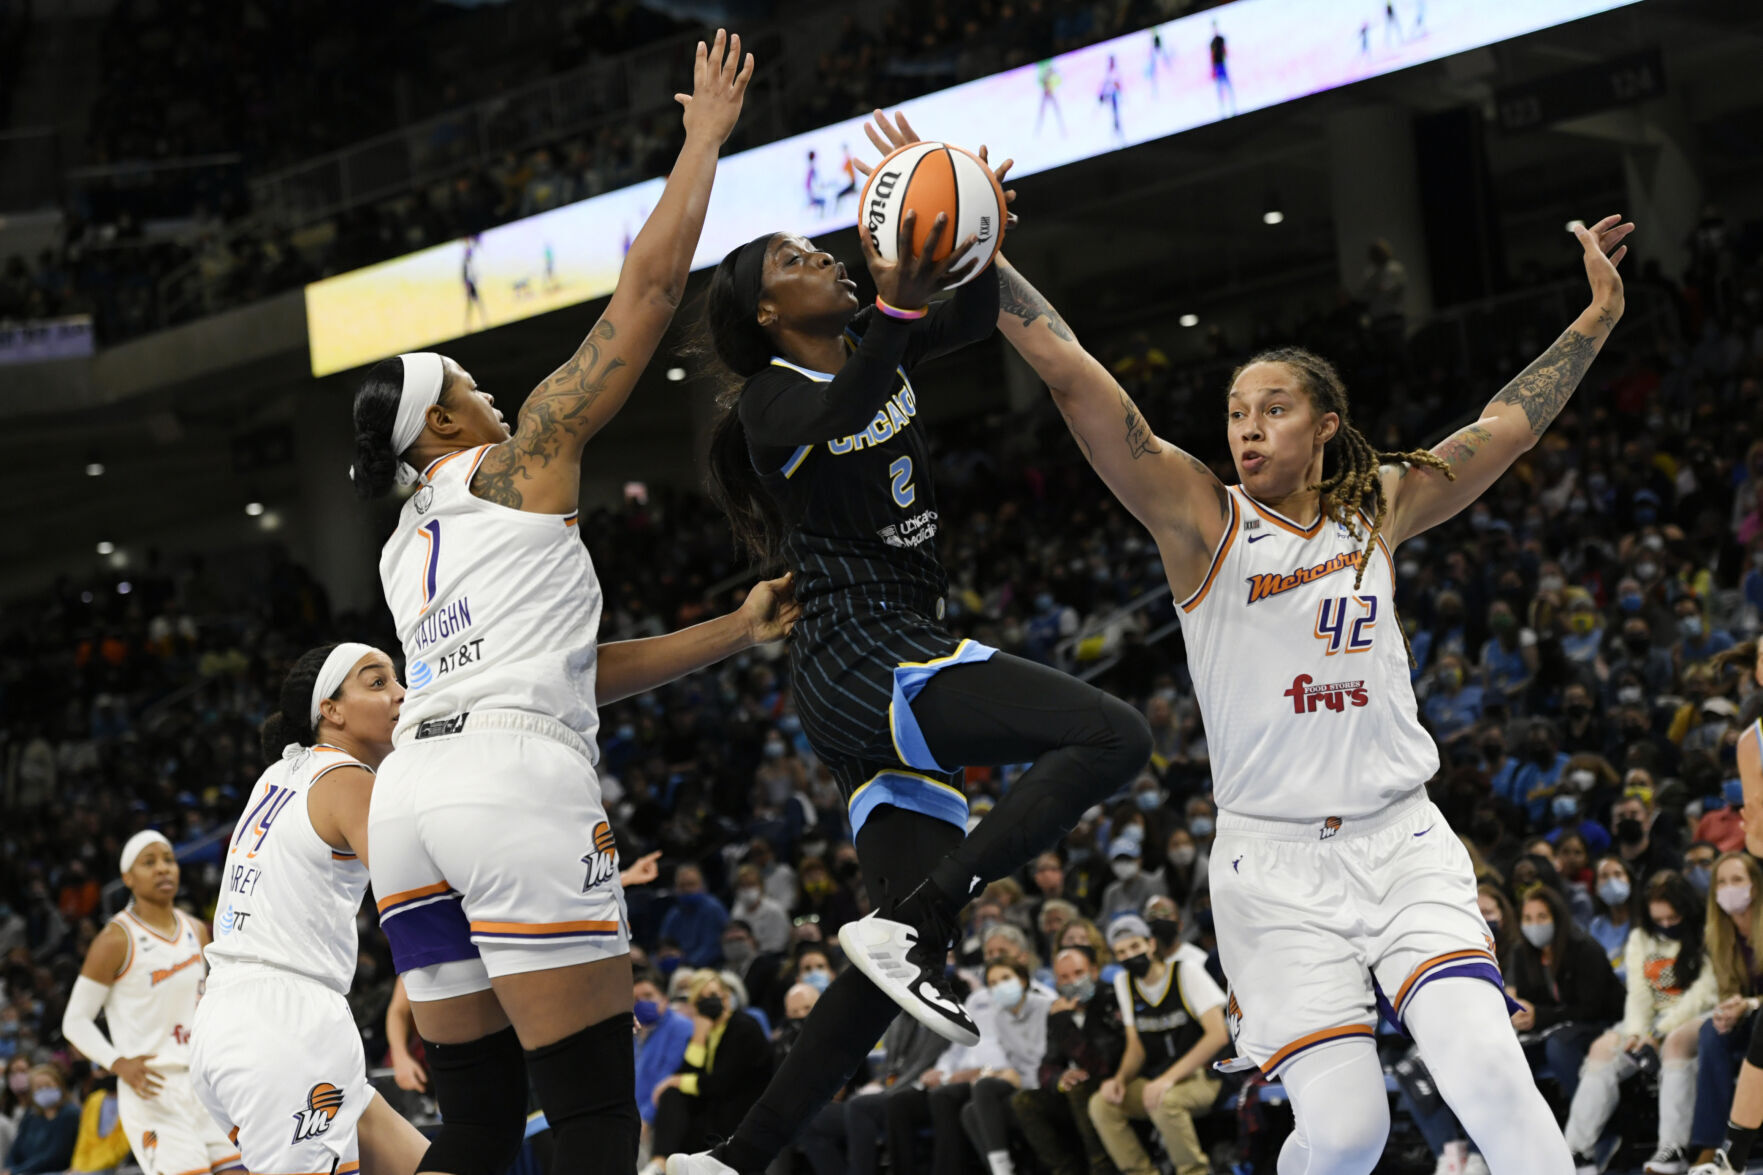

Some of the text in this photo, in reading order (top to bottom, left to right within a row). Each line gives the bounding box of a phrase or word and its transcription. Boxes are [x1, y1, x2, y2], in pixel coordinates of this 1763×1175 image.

[869, 171, 902, 257] Wilso
[889, 455, 915, 508] 2
[418, 519, 440, 616] 1
[1246, 550, 1364, 606] Mercury
[414, 596, 472, 651] VAUGHN
[1314, 595, 1378, 657] 42
[438, 638, 485, 678] AT&T
[1284, 673, 1369, 714] fry's
[1304, 680, 1361, 694] FOOD STORES
[232, 782, 297, 859] 14
[230, 864, 262, 897] REY
